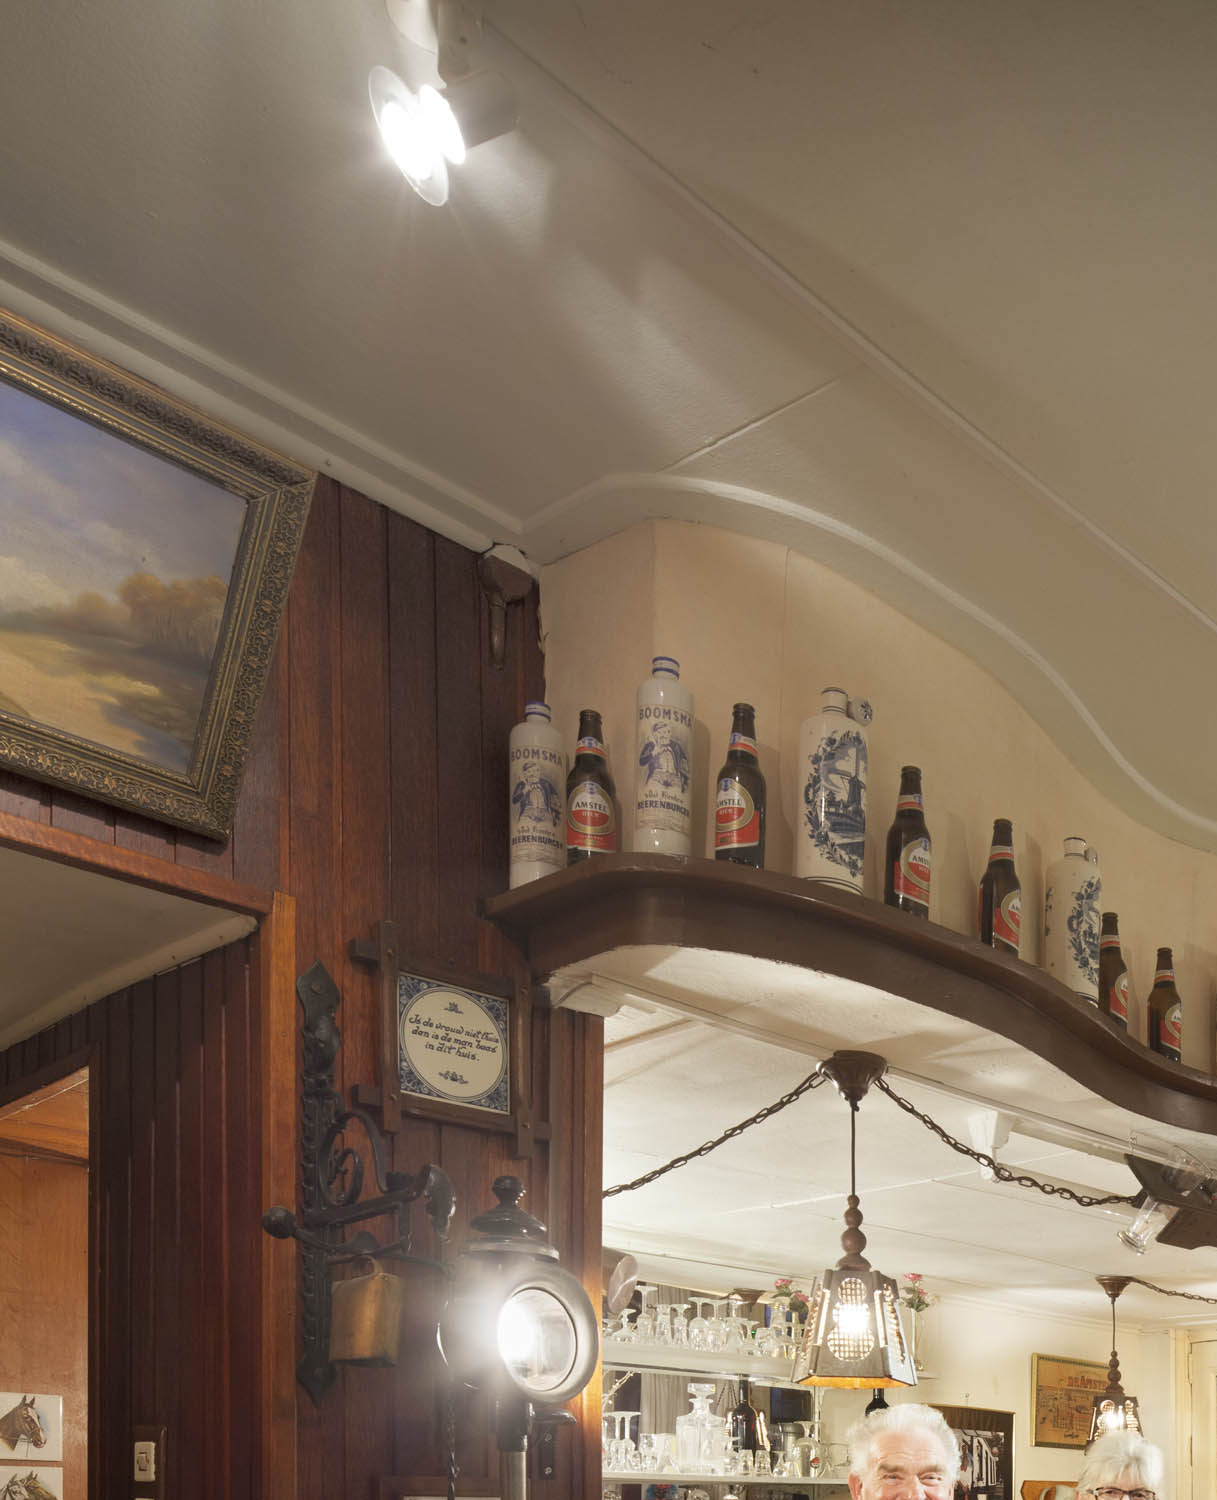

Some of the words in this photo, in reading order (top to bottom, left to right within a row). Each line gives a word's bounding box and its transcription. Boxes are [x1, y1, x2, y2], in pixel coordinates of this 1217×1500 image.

[639, 705, 693, 729] BOOMSMA
[511, 747, 563, 766] BOOMSMA
[575, 800, 609, 812] AMSTEL
[422, 1017, 434, 1028] de
[435, 1022, 465, 1035] vrouw
[411, 1026, 430, 1038] dan
[440, 1033, 453, 1043] de
[453, 1038, 473, 1048] man
[424, 1042, 435, 1050] in
